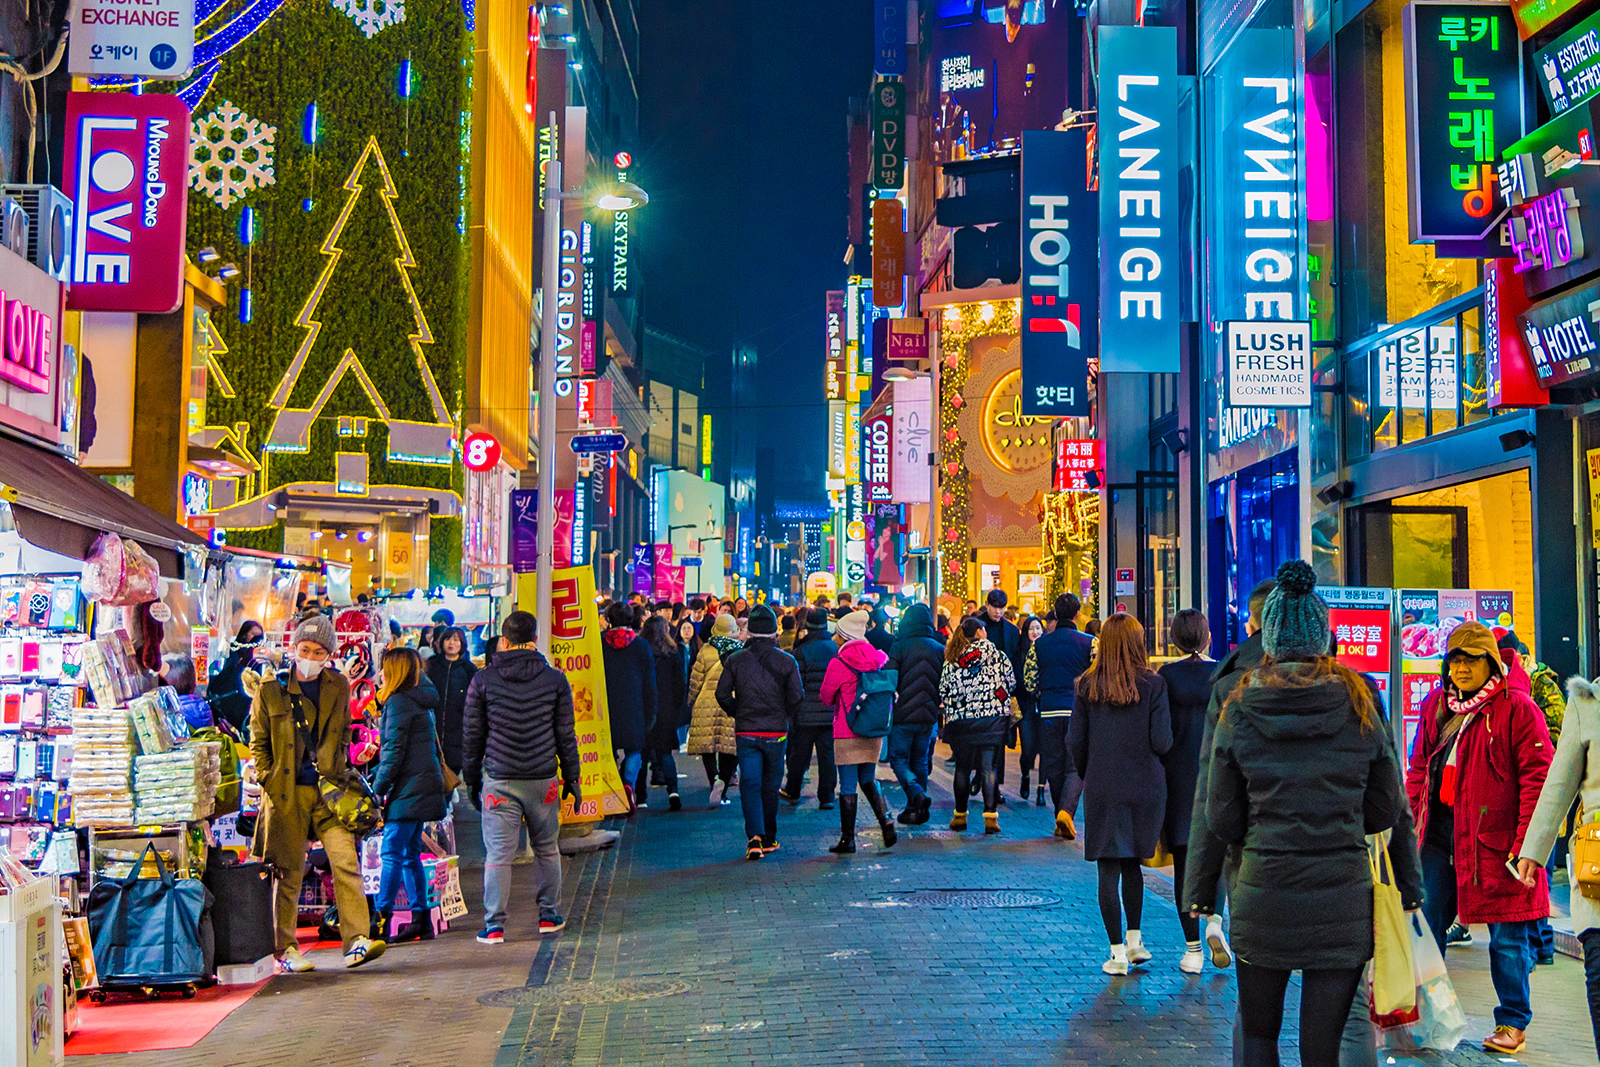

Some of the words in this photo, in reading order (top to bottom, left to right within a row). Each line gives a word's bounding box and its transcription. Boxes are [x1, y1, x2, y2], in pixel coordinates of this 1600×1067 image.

[81, 8, 180, 27] EXCHANGE
[1438, 16, 1499, 51] 루키
[89, 44, 138, 60] 오케이
[155, 50, 172, 63] 1F
[1557, 29, 1600, 73] ESTHETIC
[1567, 61, 1600, 100] エステサロ
[1448, 57, 1499, 219] 노래방
[882, 121, 898, 184] DVD방
[1496, 153, 1527, 208] 루키
[75, 117, 138, 284] LOVE
[1117, 74, 1162, 320] LANEIGE
[1507, 188, 1568, 275] 노래방
[613, 211, 629, 292] SKYPARK
[553, 229, 579, 398] GIORDANO
[0, 289, 52, 394] LOVE
[890, 334, 927, 348] Nail
[1235, 333, 1304, 351] LUSH
[1543, 316, 1597, 363] HOTEL
[1235, 355, 1305, 370] FRESH
[1236, 373, 1305, 383] HANDMADE
[1036, 385, 1075, 406] 핫티
[1236, 385, 1305, 395] COSMETICS
[872, 420, 889, 483] COFFEE
[1066, 442, 1094, 456] 高丽
[593, 450, 611, 503] Roem
[1072, 479, 1087, 488] 2F
[573, 511, 585, 564] FRIENDS
[392, 551, 409, 564] 50
[1344, 590, 1385, 600] 명동월드점
[1444, 600, 1471, 609] 소금구이
[1336, 625, 1382, 643] 美容室
[1348, 645, 1364, 655] OK!
[585, 774, 600, 786] 4F
